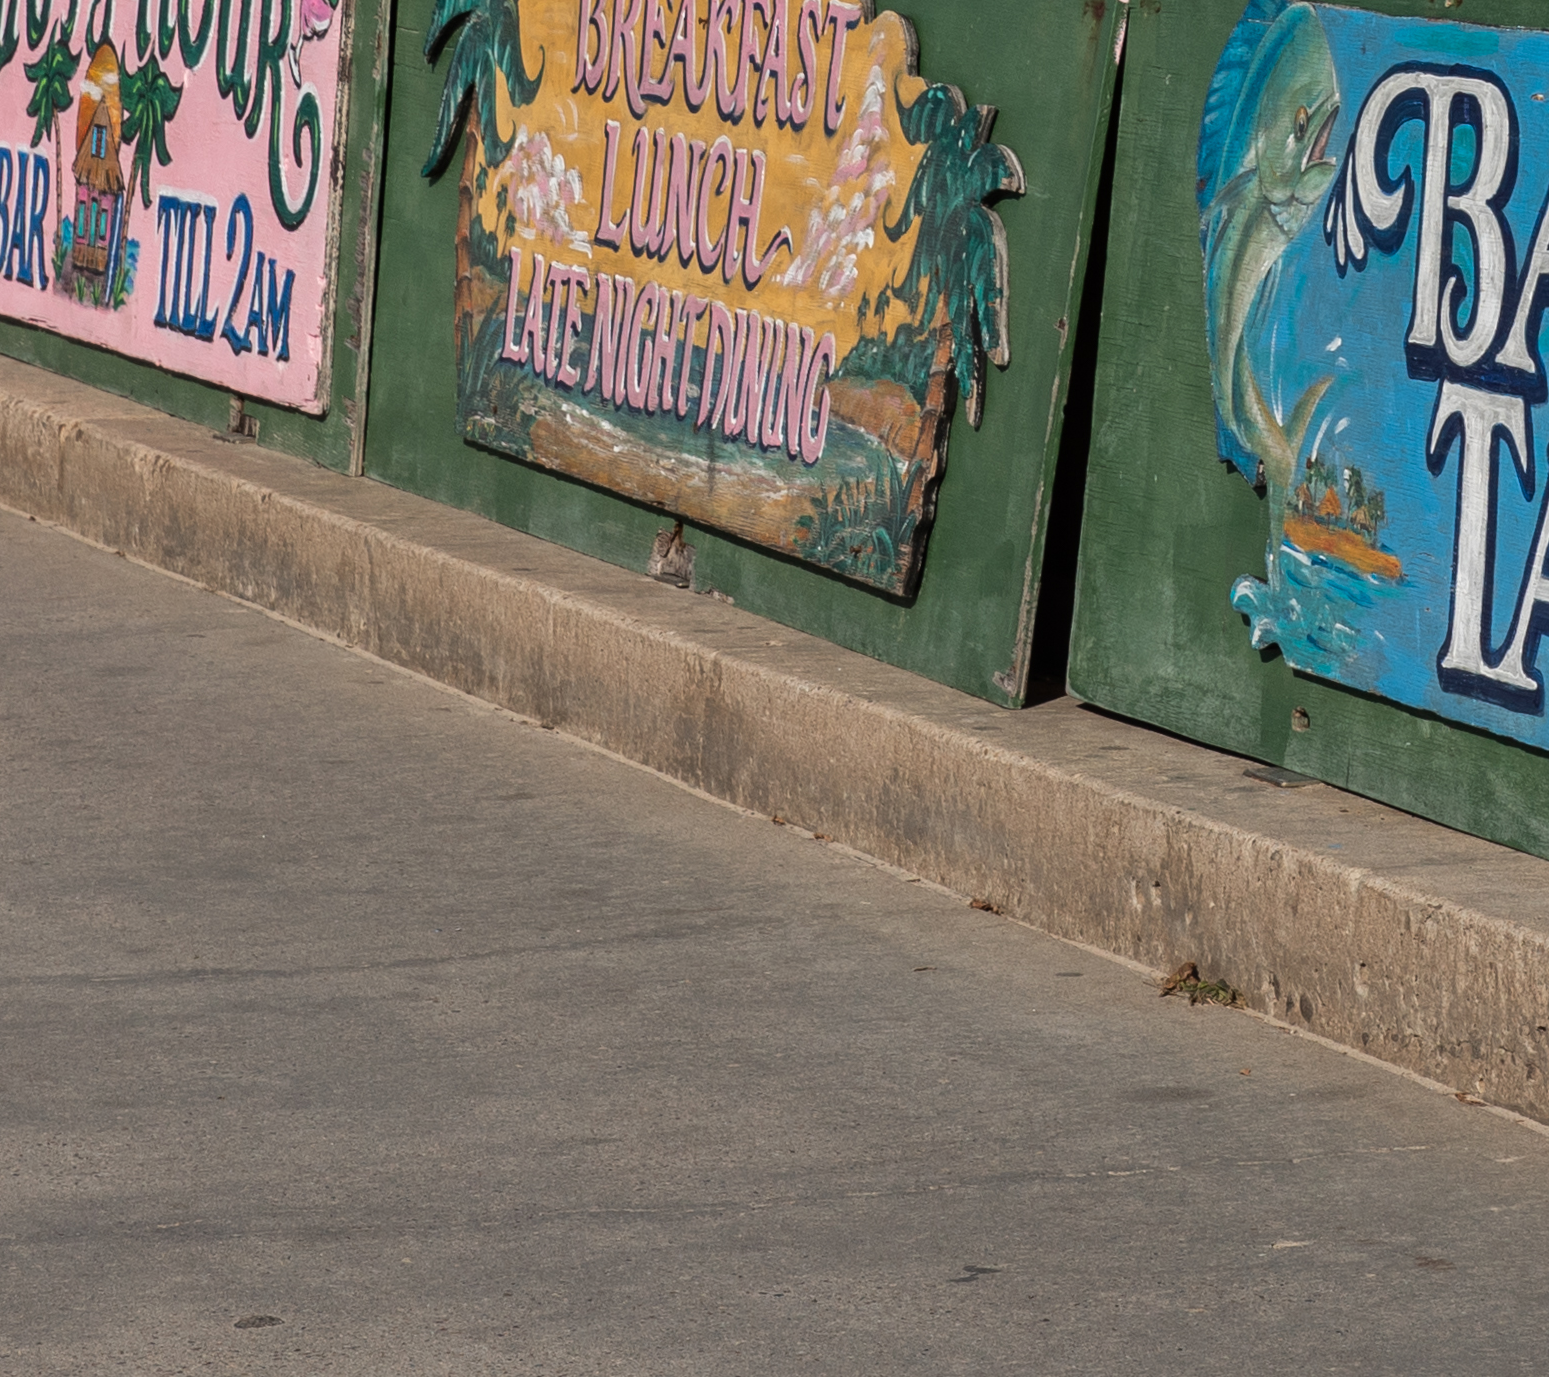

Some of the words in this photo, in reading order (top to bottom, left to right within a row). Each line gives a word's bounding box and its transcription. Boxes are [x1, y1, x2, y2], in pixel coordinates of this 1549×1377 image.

[154, 188, 219, 340] TILL
[221, 191, 297, 363] 2AM
[595, 119, 793, 292] LUNCH
[501, 246, 591, 389] LATE
[582, 271, 709, 420] NIGHT
[696, 301, 837, 466] DINING
